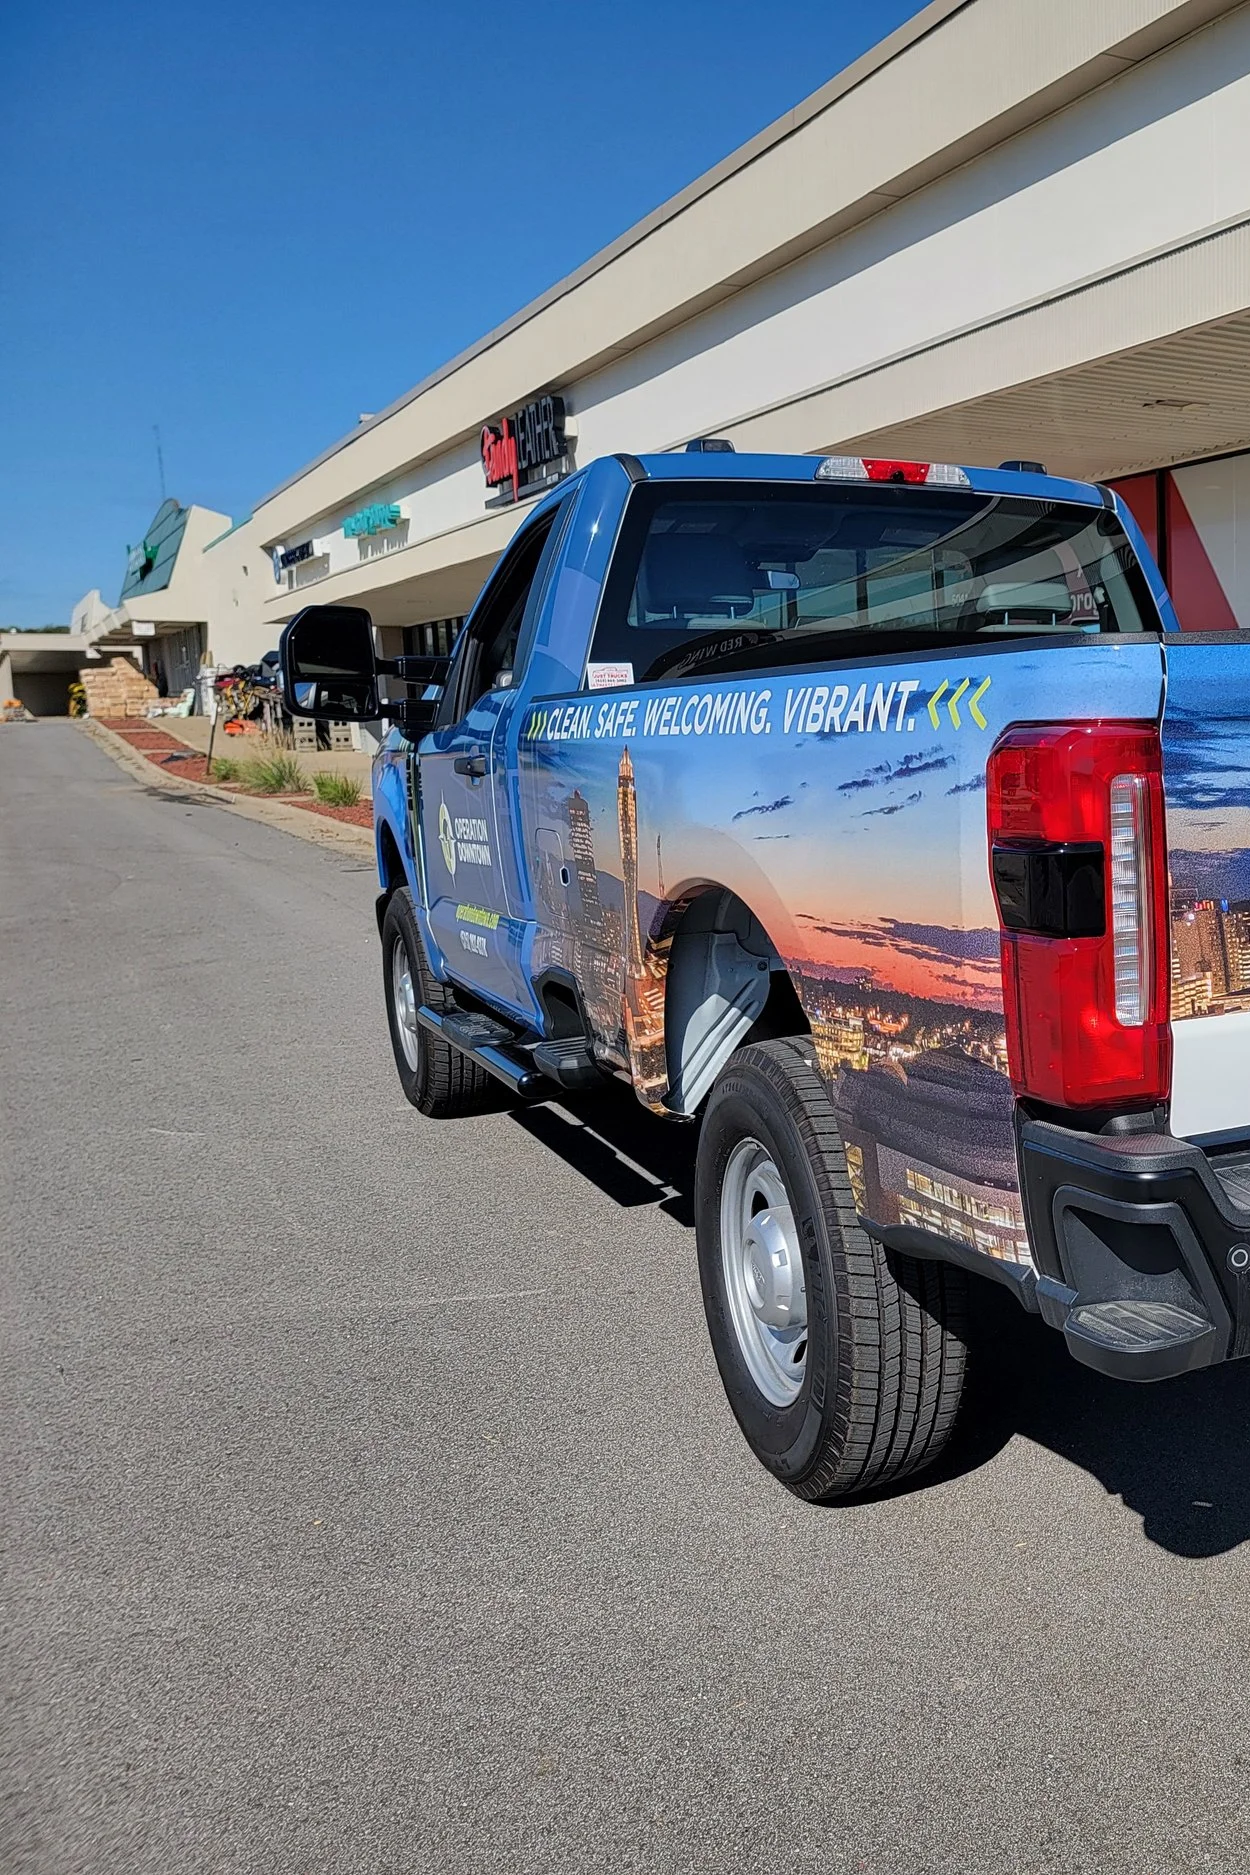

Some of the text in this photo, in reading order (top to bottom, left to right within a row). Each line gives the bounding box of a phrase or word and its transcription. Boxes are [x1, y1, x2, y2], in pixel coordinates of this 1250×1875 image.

[547, 679, 921, 741] CLEAN. SAFE. WELCOMING. VIBRANT.
[454, 817, 489, 842] OPERATION
[457, 841, 492, 867] DOWNTOWN
